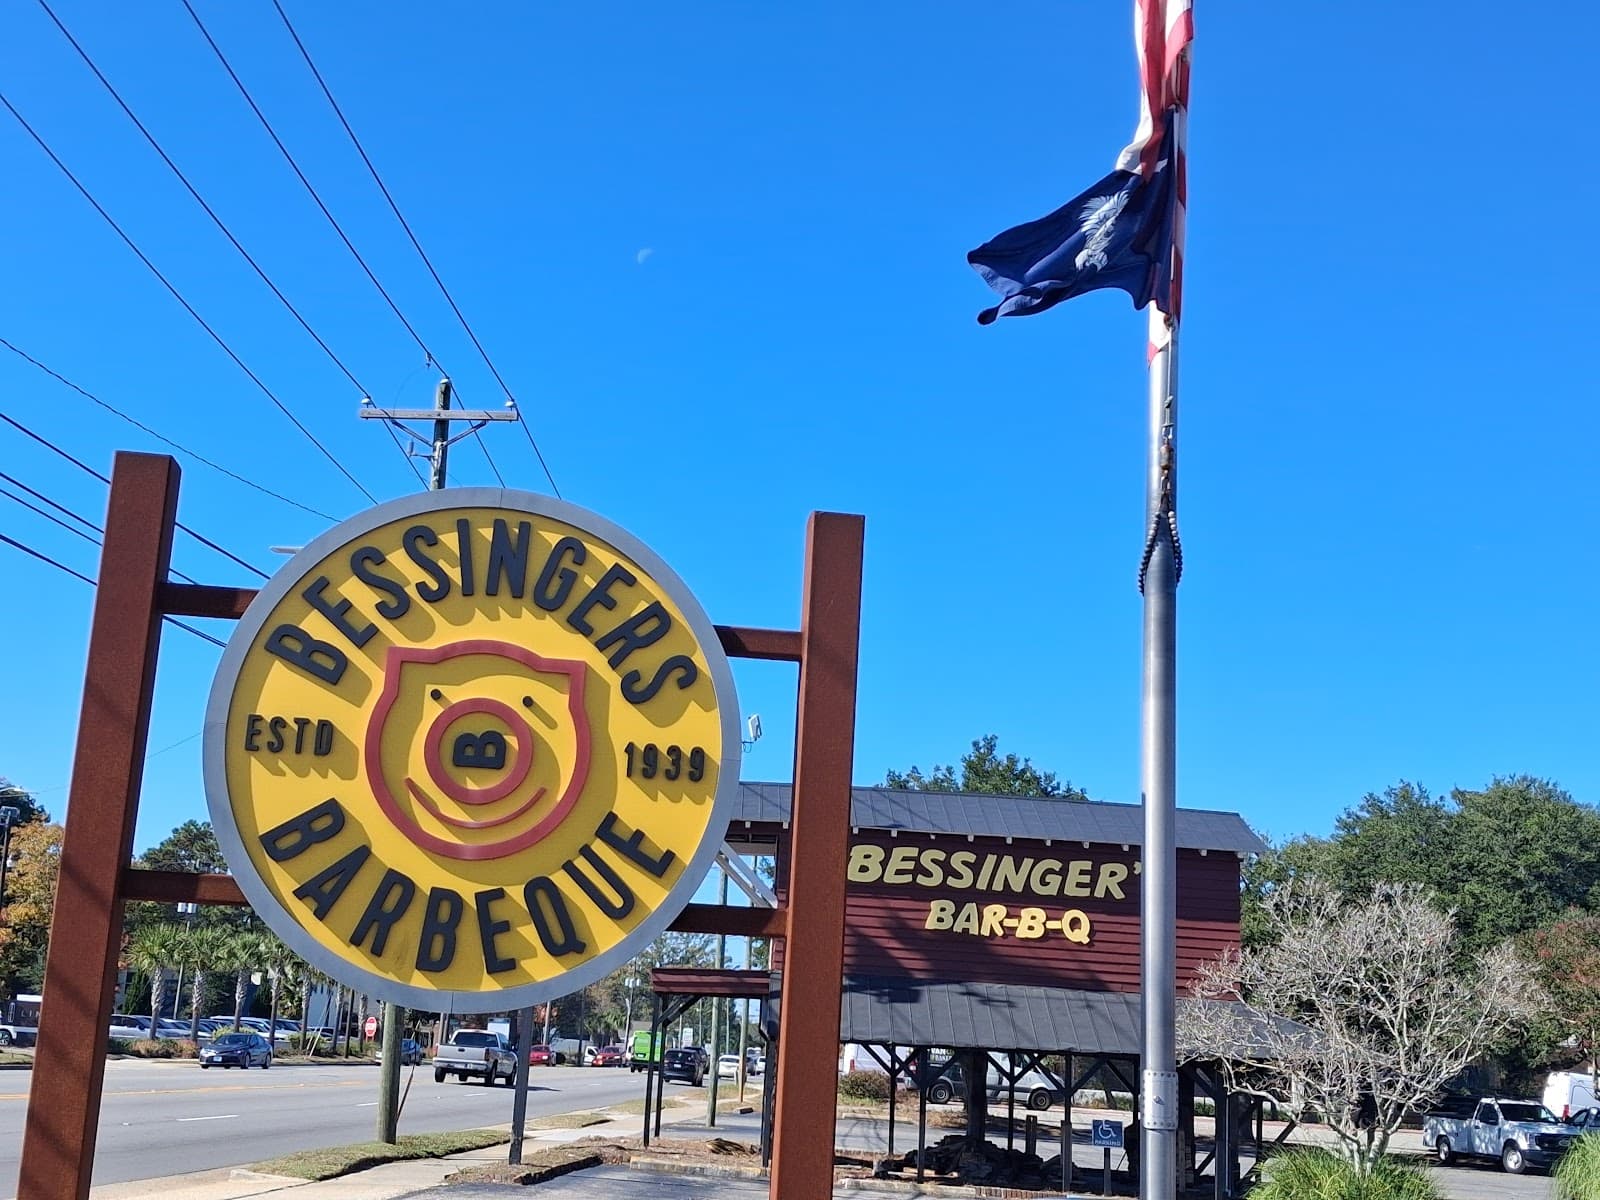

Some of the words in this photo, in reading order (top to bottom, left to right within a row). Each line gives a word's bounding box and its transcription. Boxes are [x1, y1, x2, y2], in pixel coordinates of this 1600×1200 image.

[264, 518, 698, 704] BESSINGERS
[244, 714, 334, 756] ESTD
[452, 730, 507, 770] B
[623, 741, 705, 783] 1939
[258, 797, 676, 974] BARBEQUE
[924, 899, 1091, 945] BAR-B-Q
